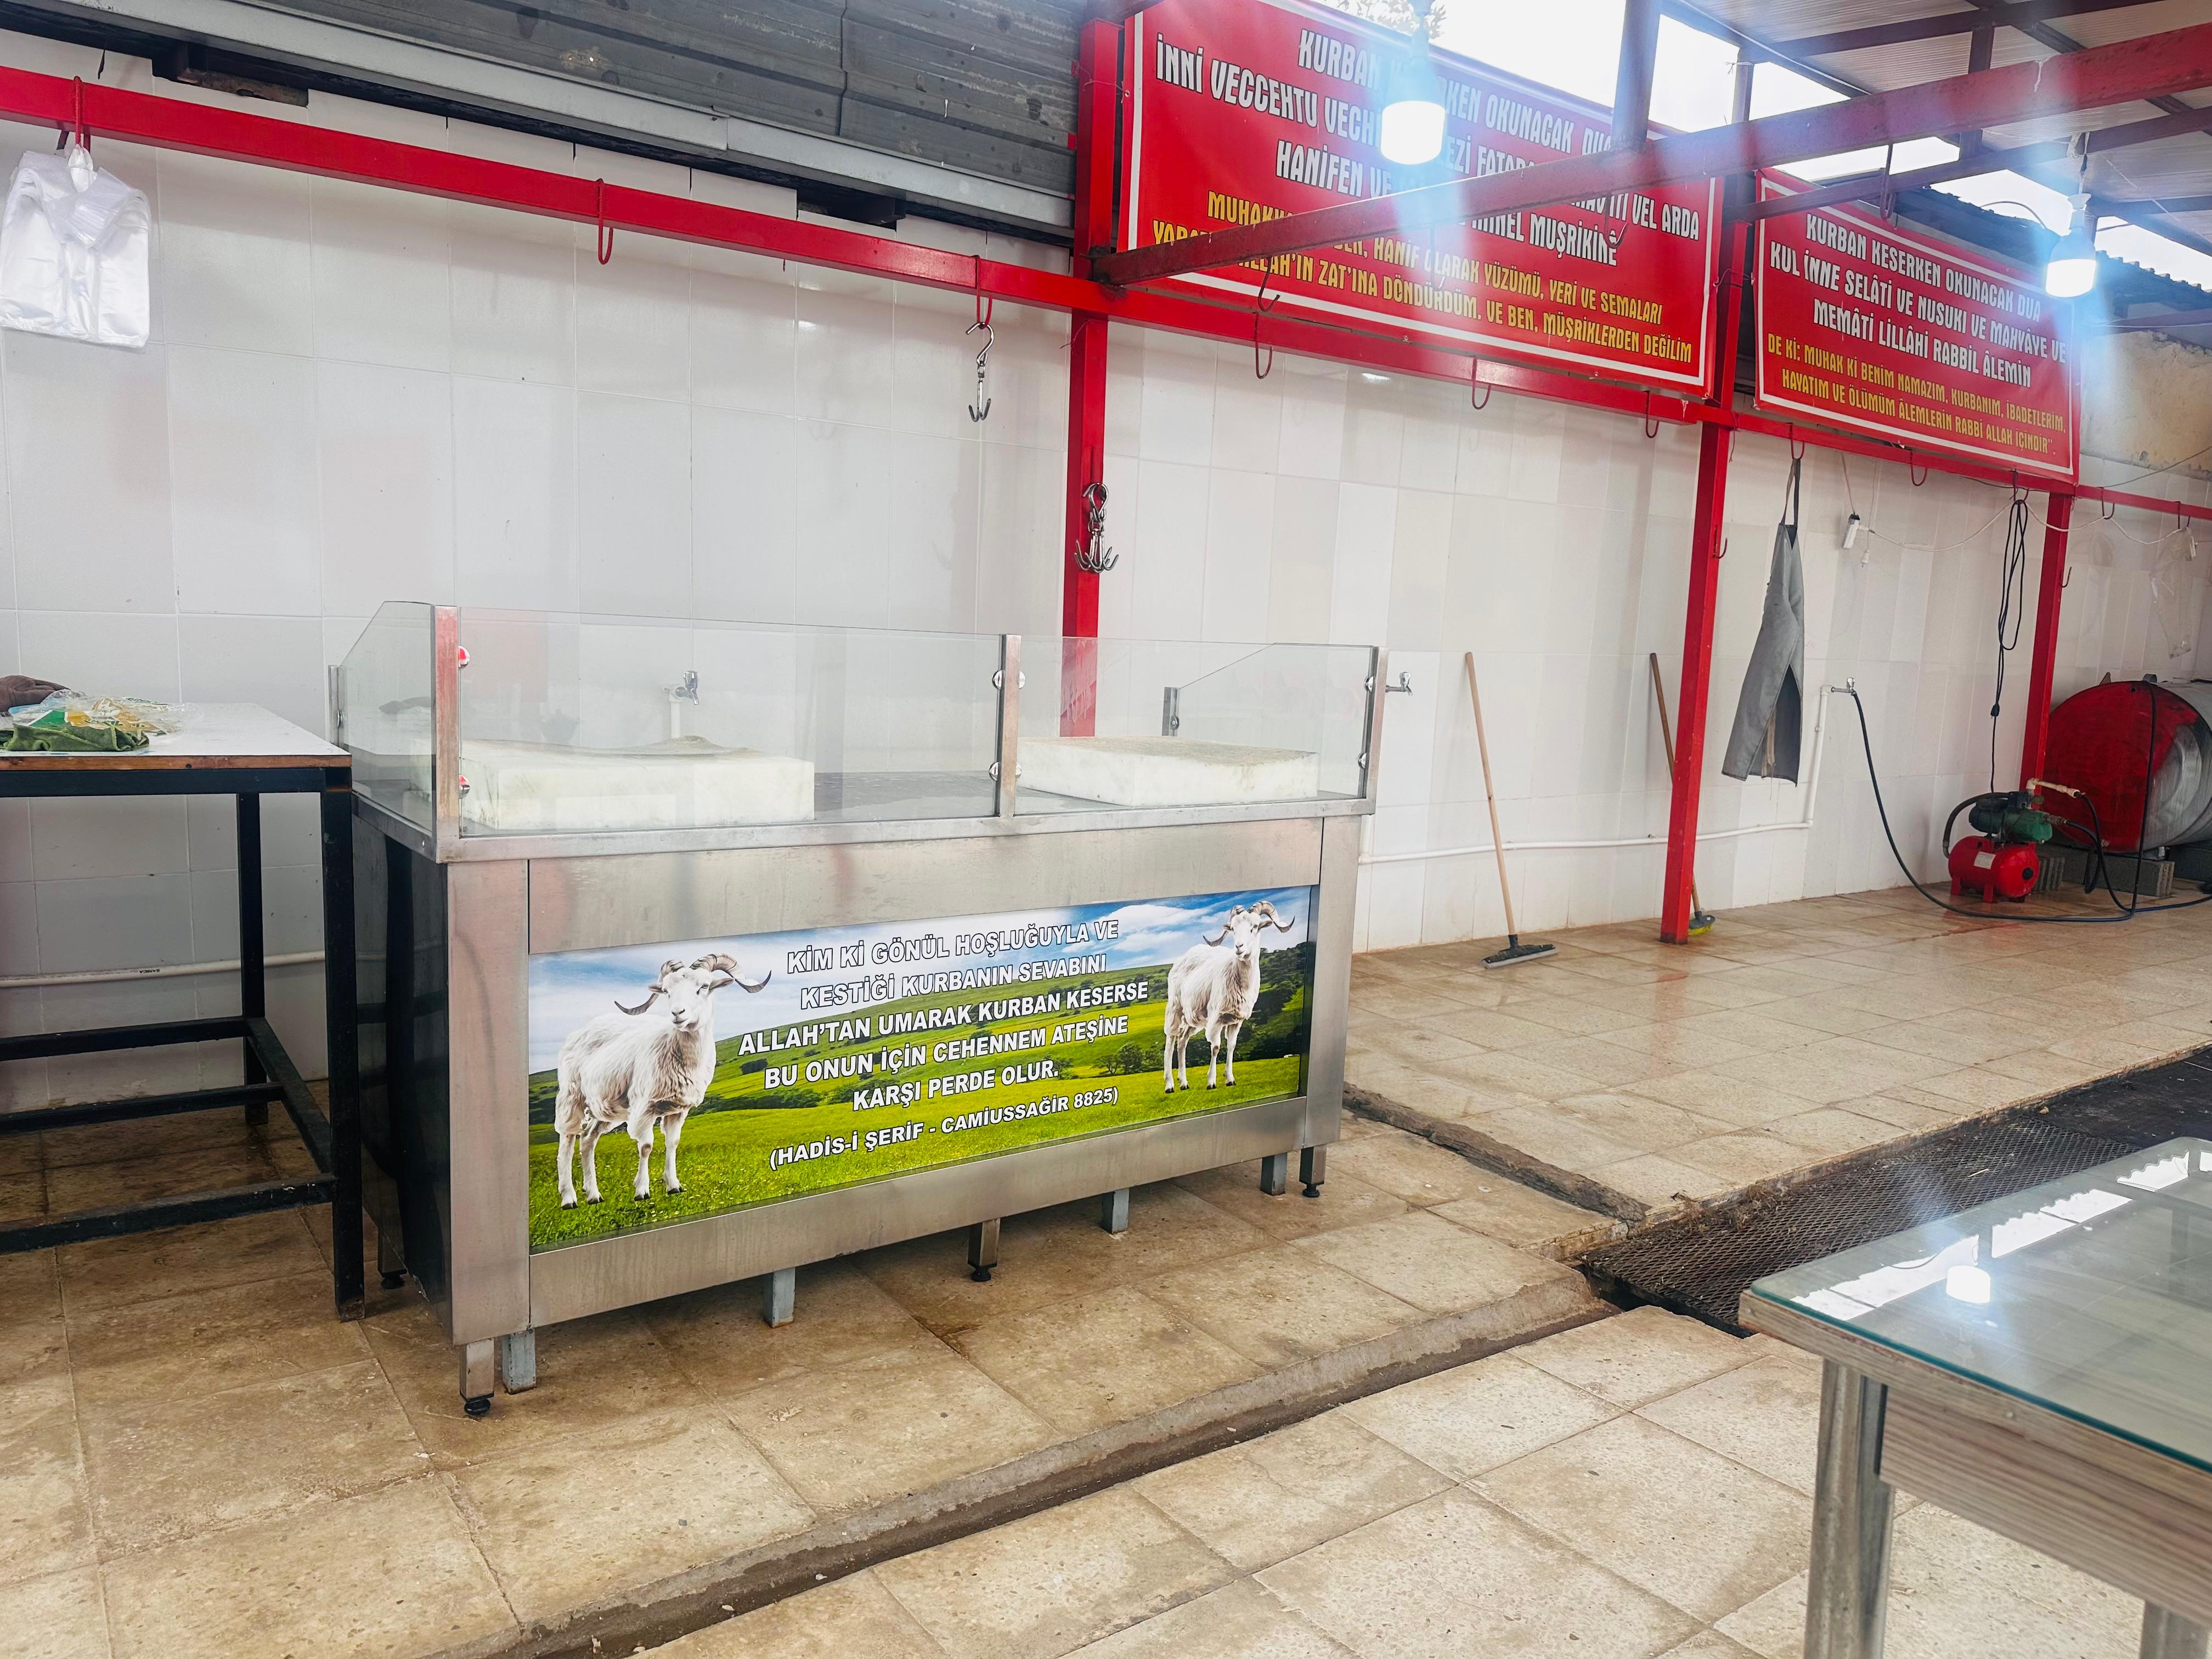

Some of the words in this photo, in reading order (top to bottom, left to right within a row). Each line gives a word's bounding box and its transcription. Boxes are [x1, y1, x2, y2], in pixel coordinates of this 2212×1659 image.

[1298, 29, 1381, 91] KURBAN
[1485, 93, 1575, 154] OKUNACAK
[1156, 32, 1204, 94] İNNİ
[1210, 59, 1318, 128] VECCEHTU
[1632, 193, 1657, 229] VEL
[1661, 203, 1699, 241] ARDA
[1276, 139, 1364, 198] HANİFEN
[1374, 237, 1420, 268] HANİF
[1483, 260, 1544, 300] YÜZÜMÜ,
[1549, 280, 1578, 307] YERİ
[1581, 287, 1597, 310] VE
[1600, 291, 1663, 325] SEMALARI
[1770, 241, 1800, 276] KUL
[1803, 249, 1840, 291] İNNE
[1844, 269, 1892, 308] SELÂTİ
[1897, 287, 1914, 316] VE
[1917, 295, 1966, 334] NUSUKI
[1971, 313, 1986, 340] VE
[1990, 320, 2047, 358] MAHYÂYE
[2051, 340, 2066, 363] VE
[1806, 213, 1866, 261] KURBAN
[1871, 239, 1940, 287] KESERKEN
[1945, 268, 2013, 313] OKUNACAK
[2017, 294, 2041, 322] DUA
[1383, 274, 1481, 320] DÖNDÜRDÜM.
[1486, 300, 1503, 325] VE
[1508, 304, 1538, 333] BEN,
[1543, 312, 1639, 353] MÜŞRİKLERDEN
[1643, 334, 1692, 363] DEĞİLİM
[1813, 298, 1874, 342] MEMÂTİ
[1878, 318, 1928, 359] LİLLÂHİ
[1933, 338, 1979, 374] RABBİL
[1983, 349, 2031, 388] ÂLEMİN
[1768, 332, 1782, 356] DE
[1785, 337, 1801, 361] Kİ:
[1804, 344, 1843, 374] MUHAK
[1847, 356, 1857, 378] Kİ
[1861, 362, 1894, 388] BENİM
[1782, 368, 1829, 399] HAYATIM
[1832, 382, 1846, 404] VE
[1849, 384, 1895, 417] ÖLÜMÜM
[1899, 398, 1952, 431] ÂLEMLERİN
[1955, 416, 1983, 438] RABBİ
[1986, 424, 2012, 445] ALLAH
[787, 945, 833, 974] KİM
[840, 940, 864, 968] Kİ
[871, 934, 950, 964] GÖNÜL
[956, 923, 1089, 957] HOŞLUĞUYLA
[1094, 920, 1119, 940] VE
[800, 973, 895, 1009] KESTİĞİ
[902, 964, 1013, 997] KURBANIN
[1018, 953, 1107, 982] SEVABINI
[737, 1017, 871, 1056] ALLAH'TAN
[878, 1003, 972, 1036] UMARAK
[978, 992, 1060, 1022] KURBAN
[1066, 981, 1148, 1010] KESERSE
[764, 1064, 798, 1090] BU
[805, 1053, 873, 1082] ONUN
[881, 1042, 927, 1075] İÇİN
[933, 1027, 1046, 1063] CEHENNEM
[1051, 1014, 1128, 1044] ATEŞİNE
[853, 1081, 921, 1111] KARŞI
[928, 1069, 996, 1099] PERDE
[1001, 1059, 1058, 1086] OLUR.
[769, 1131, 859, 1171] (HADİS-İ
[865, 1121, 924, 1152] ŞERİF
[941, 1094, 1069, 1133] CAMİUSSAĞİR
[1073, 1087, 1119, 1109] 8825)
